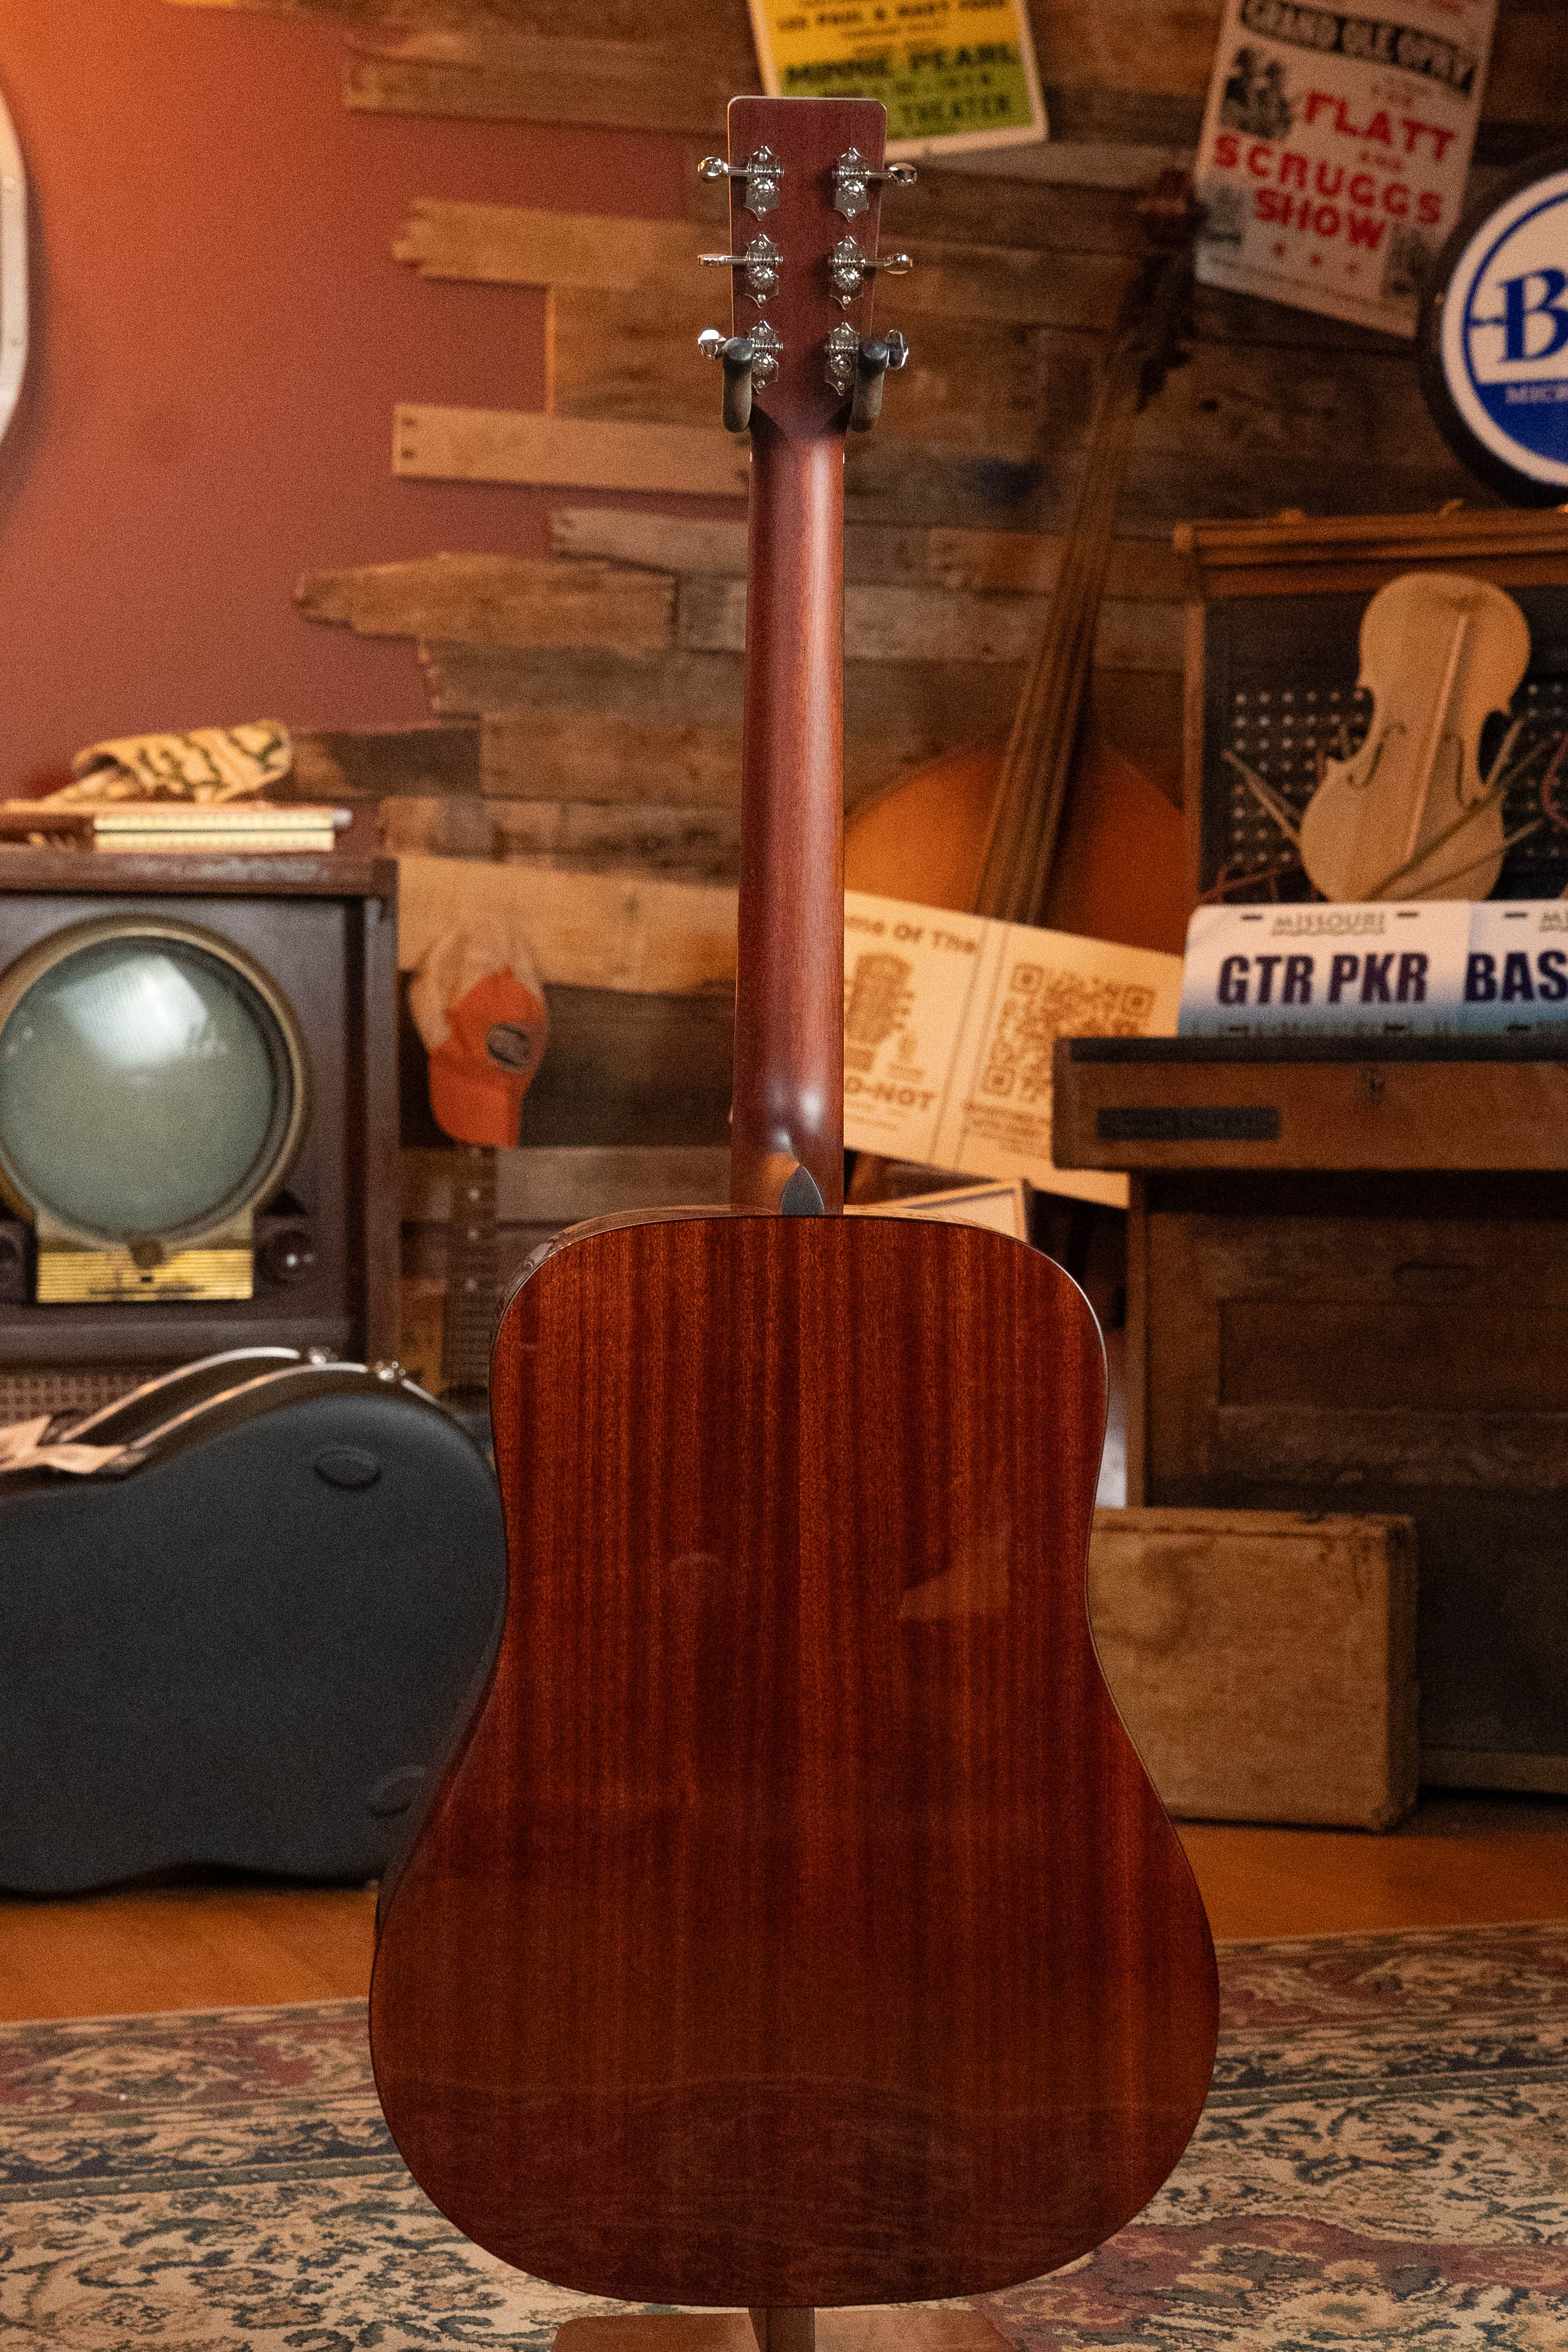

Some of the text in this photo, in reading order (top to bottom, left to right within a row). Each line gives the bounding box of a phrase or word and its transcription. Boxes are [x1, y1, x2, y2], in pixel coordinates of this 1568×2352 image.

[1304, 91, 1455, 163] FLATT
[1214, 134, 1444, 226] SCRUGGS
[1255, 188, 1386, 250] SHOW
[1274, 911, 1386, 932] MISSOURI
[1218, 952, 1428, 1006] GTR PKR
[1464, 950, 1568, 1002] BAS
